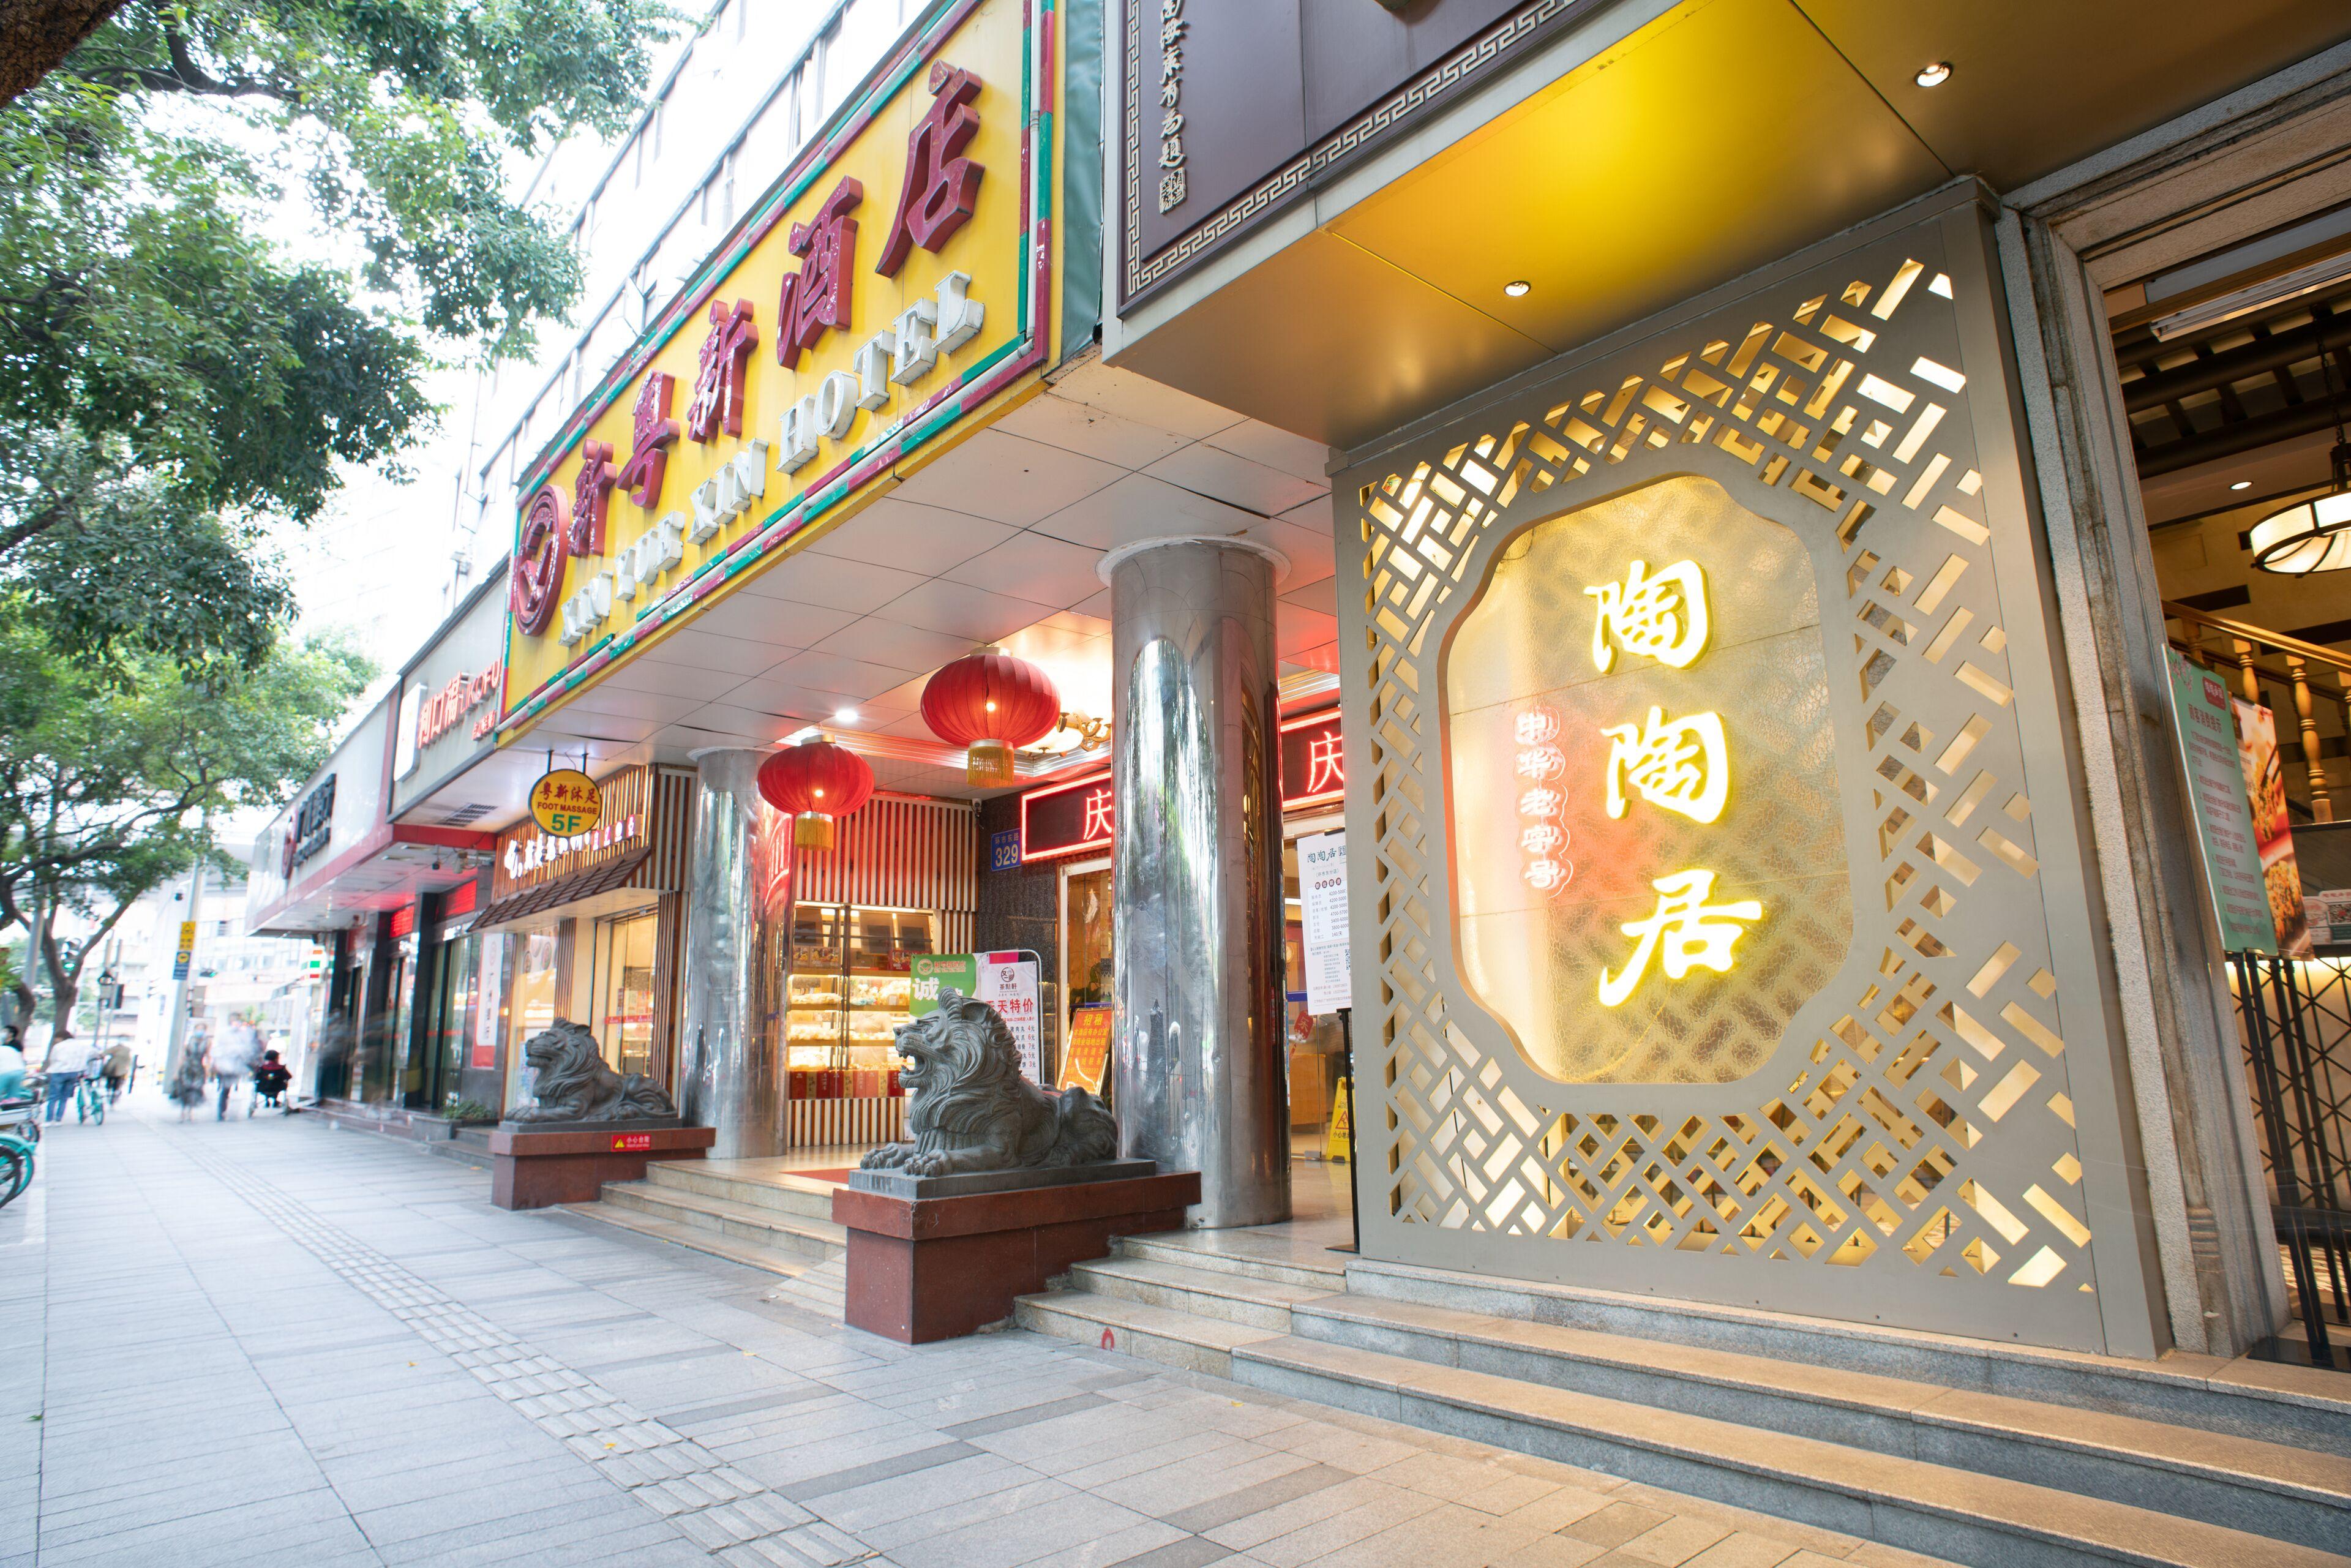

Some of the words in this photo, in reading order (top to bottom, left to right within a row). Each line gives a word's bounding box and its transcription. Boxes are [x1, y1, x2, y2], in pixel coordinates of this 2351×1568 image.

[558, 569, 613, 648] XIN
[614, 511, 685, 601] YUE
[688, 438, 769, 546] XIN
[776, 269, 984, 475] HOTEL
[1307, 730, 1344, 794] 庆
[539, 781, 598, 805] 粤新沐足
[1583, 558, 1768, 1007] 陶陶居
[538, 802, 558, 811] FOOT
[560, 804, 598, 815] MASSAGE
[1515, 710, 1565, 889] 中华老字号
[551, 813, 582, 833] 5F
[995, 833, 1019, 845] 环市东路
[995, 844, 1018, 867] 329
[1307, 847, 1337, 863] 陶陶居
[1083, 1013, 1103, 1026] 招租
